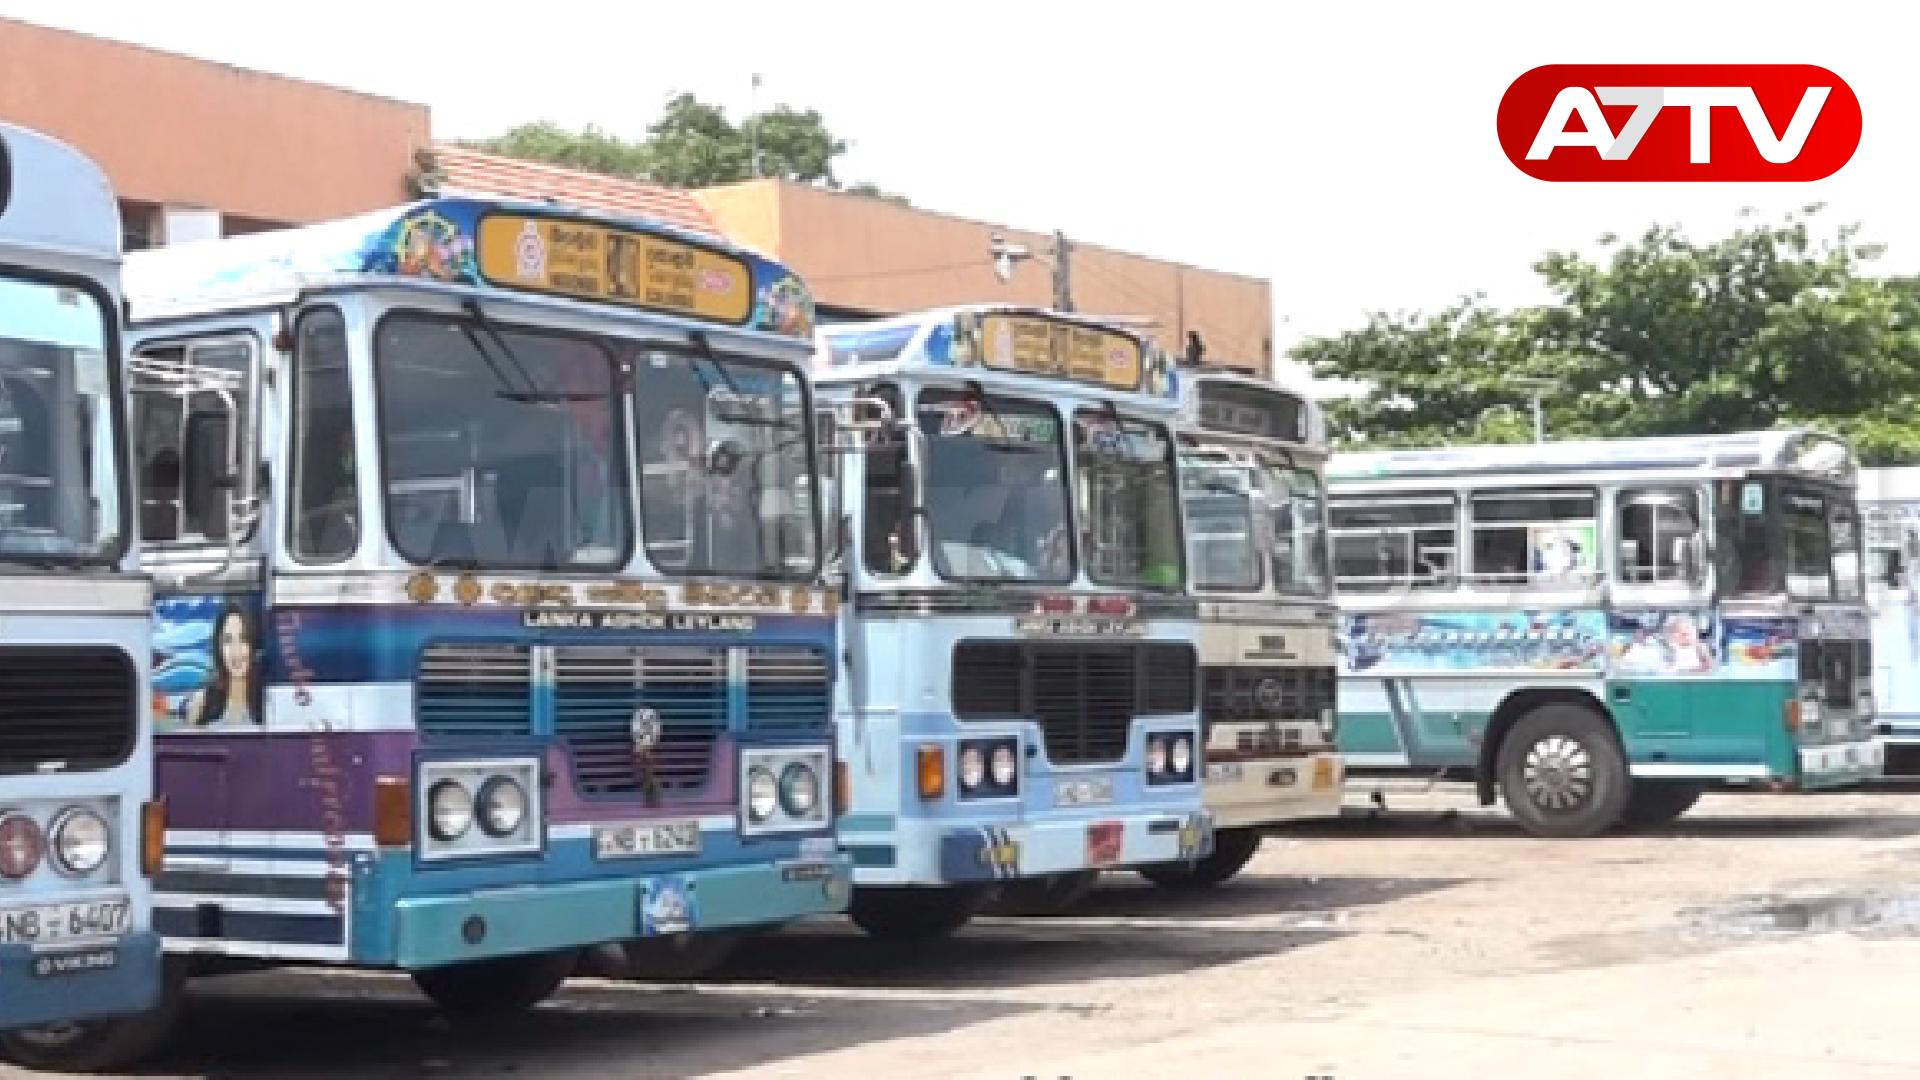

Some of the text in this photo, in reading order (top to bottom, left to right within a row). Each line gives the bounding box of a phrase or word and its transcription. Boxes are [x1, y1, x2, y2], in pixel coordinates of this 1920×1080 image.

[525, 611, 756, 632] LANKA ASHOK LEYLAND
